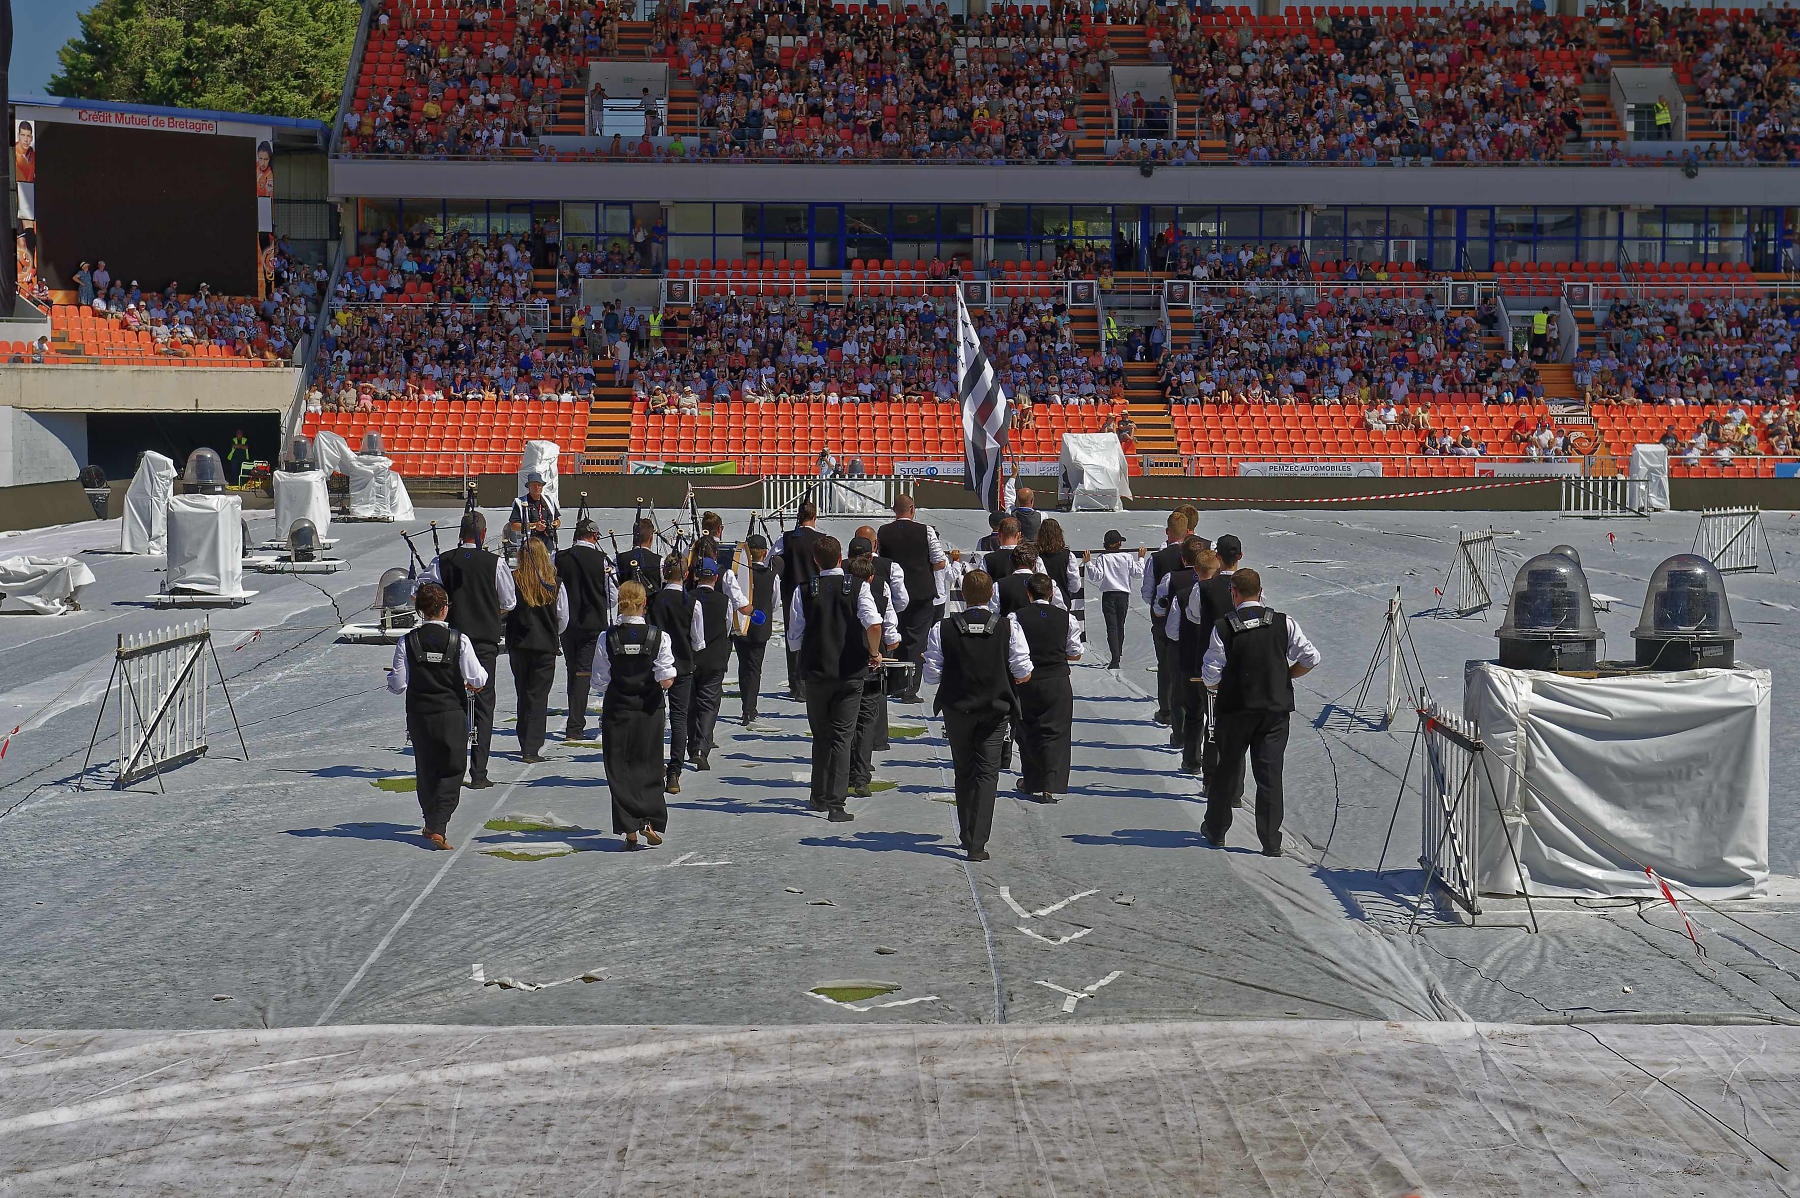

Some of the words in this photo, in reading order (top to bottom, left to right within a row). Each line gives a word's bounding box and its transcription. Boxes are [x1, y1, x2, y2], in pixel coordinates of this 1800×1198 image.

[79, 110, 112, 124] Crédit
[115, 113, 151, 127] Mutuel
[152, 117, 165, 128] de
[167, 117, 214, 132] Bretagne
[1554, 416, 1563, 425] FC
